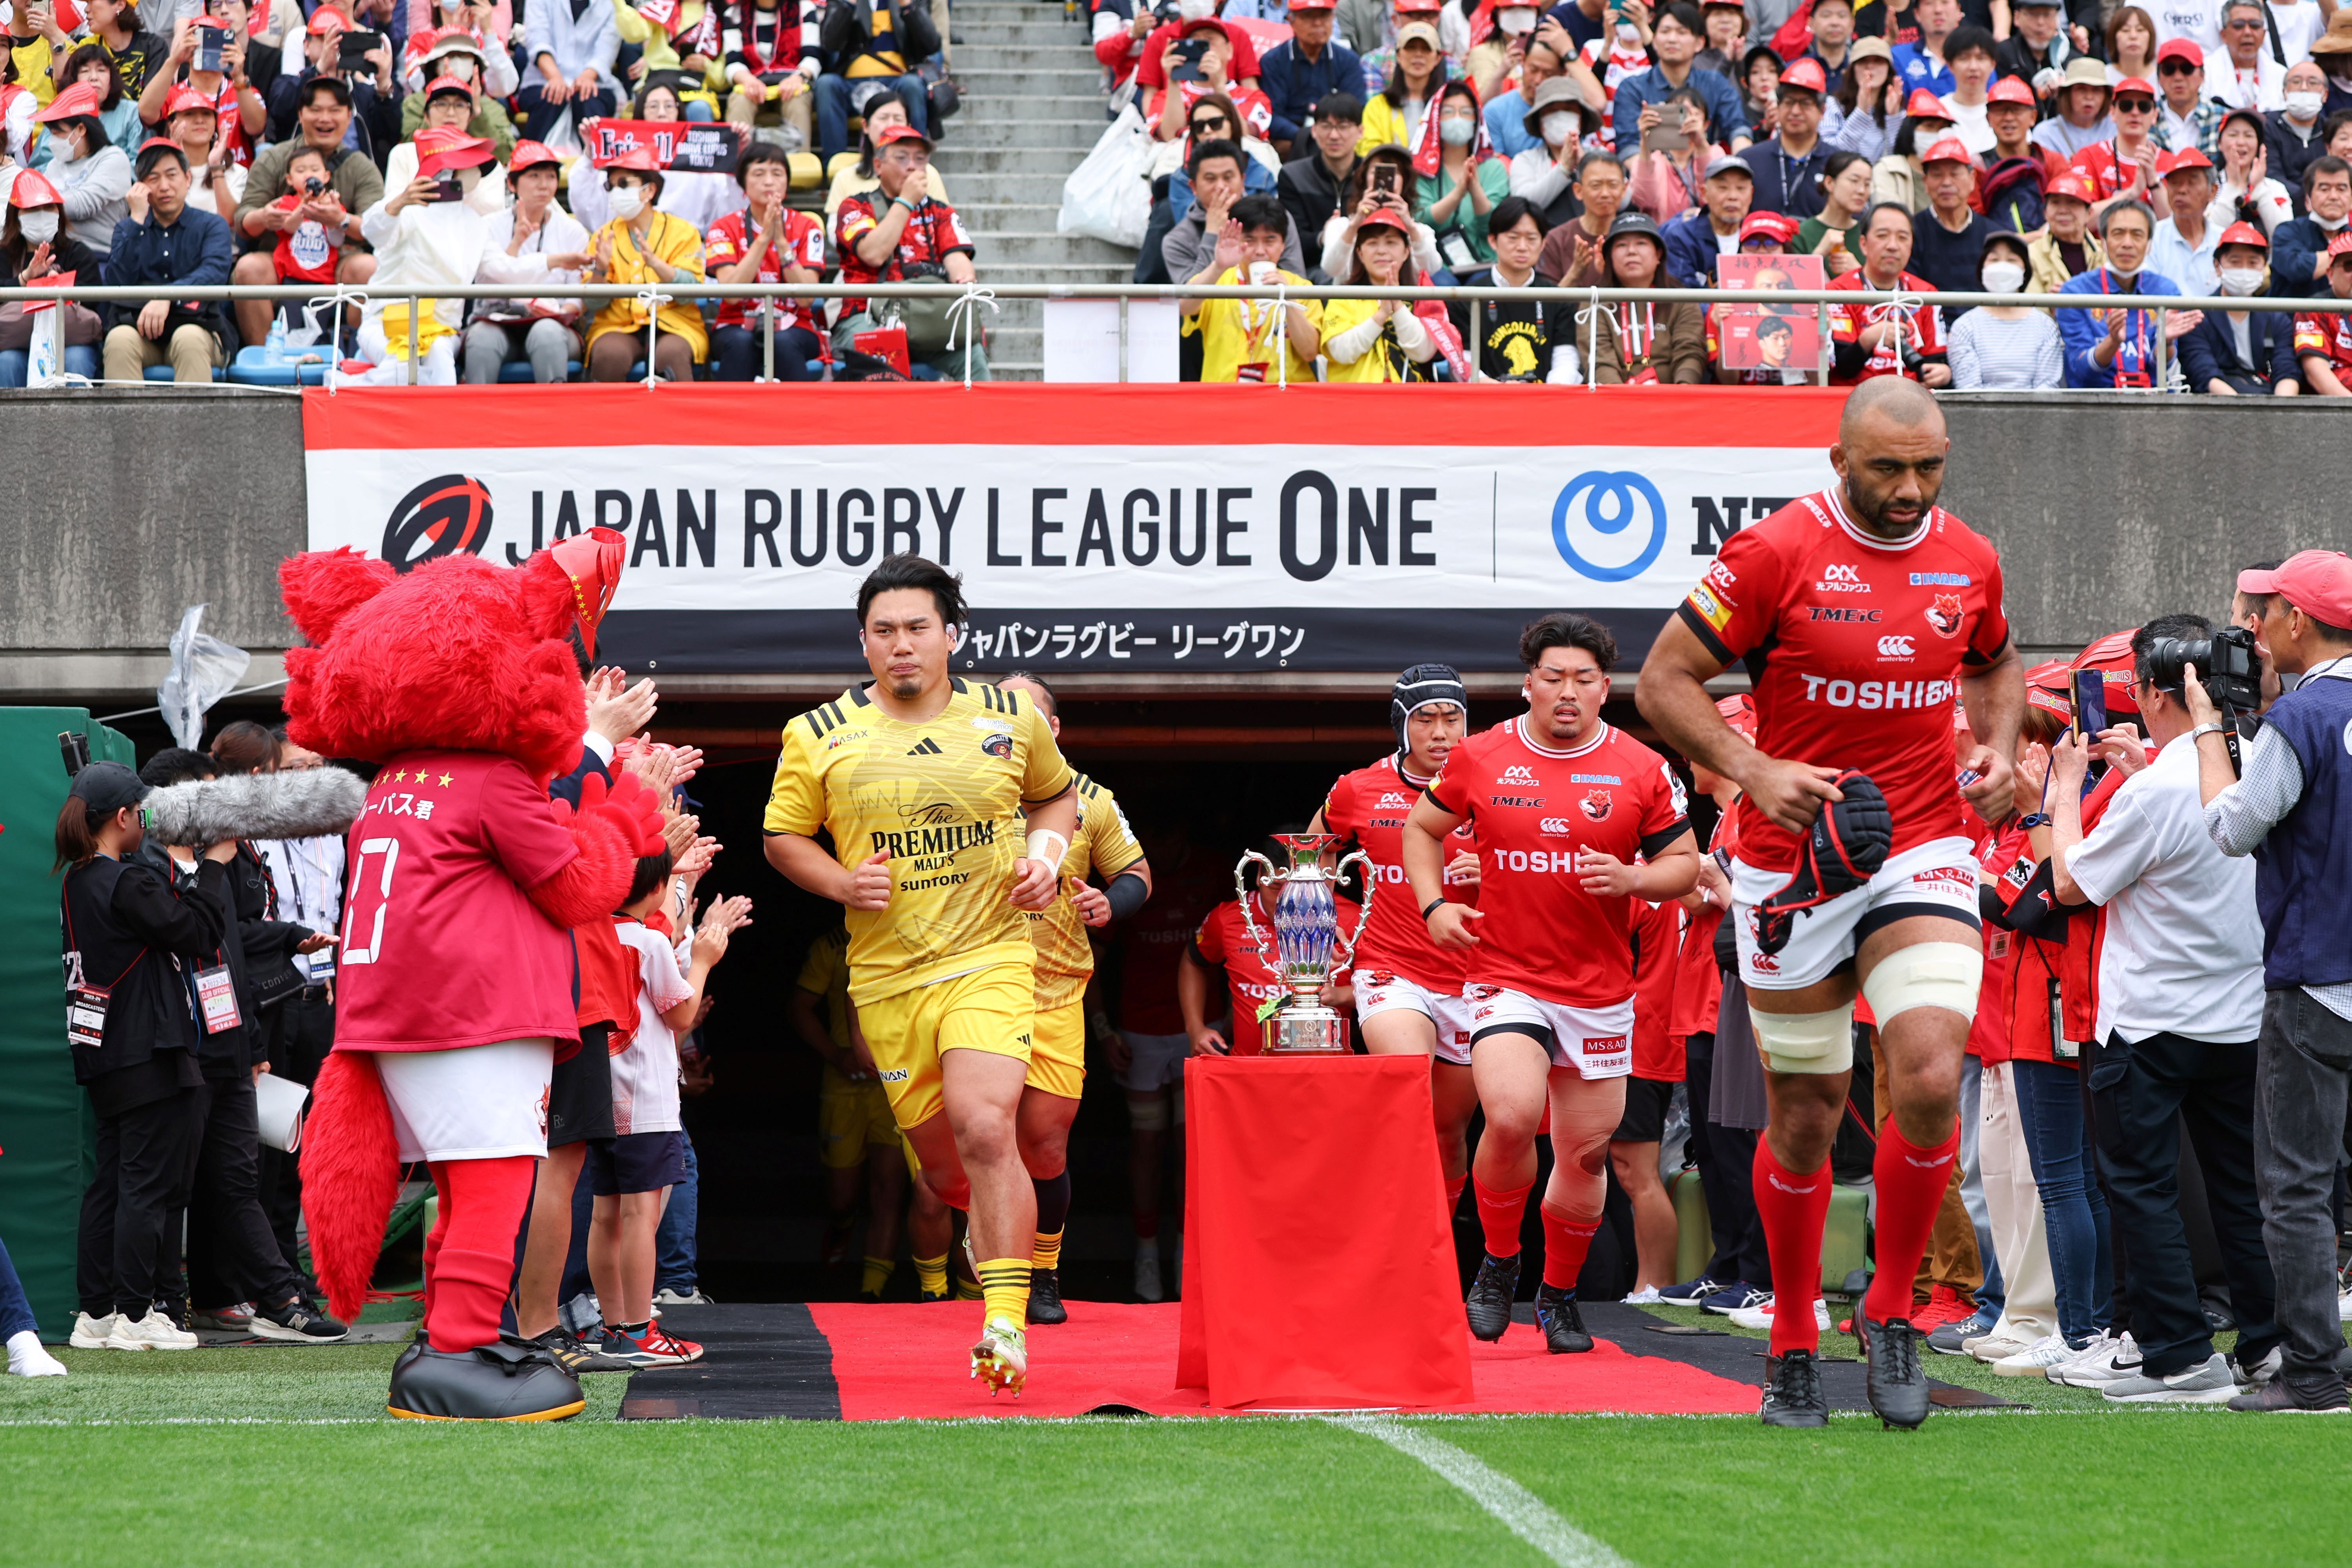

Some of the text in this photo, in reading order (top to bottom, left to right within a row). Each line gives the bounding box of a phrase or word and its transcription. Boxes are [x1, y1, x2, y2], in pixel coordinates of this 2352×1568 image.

[506, 469, 1437, 582] JAPAN RUGBY LEAGUE ONE
[1923, 572, 1971, 586] INABA
[1816, 581, 1871, 593] 光アルファクス
[1172, 621, 1305, 659] リーグワン
[2111, 671, 2131, 681] LUPUS
[1801, 673, 1954, 710] TOSHIBA
[2032, 692, 2049, 703] BRAVE
[983, 735, 1009, 749] SUNGOLIATH
[1497, 777, 1540, 786] 光アルファクス
[1581, 773, 1621, 785] INABA
[357, 792, 434, 820] ルーパス君
[898, 802, 964, 827] The
[870, 819, 994, 859] PREMIUM
[914, 853, 954, 872] MALT'S
[2011, 873, 2025, 887] LEAGUE
[213, 986, 230, 995] OFFICIAL
[83, 993, 101, 1002] 2023-24
[76, 1000, 105, 1013] BROADCASTERS
[1587, 1039, 1625, 1051] MS&AD
[1584, 1056, 1627, 1068] 三井住友海上
